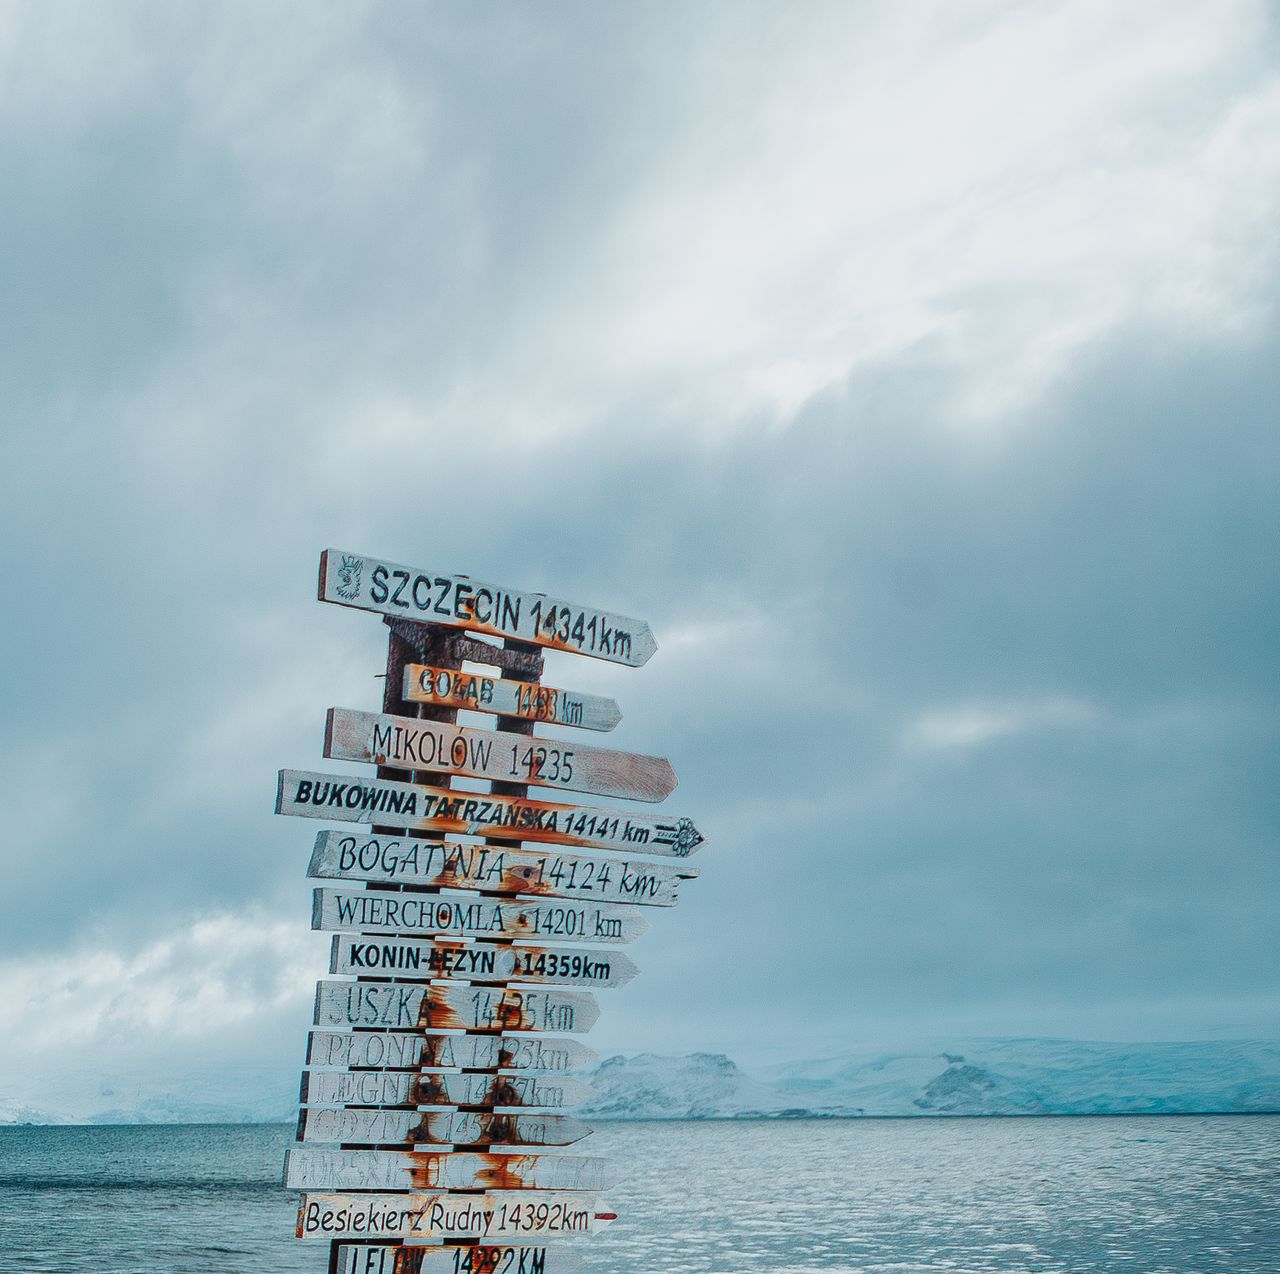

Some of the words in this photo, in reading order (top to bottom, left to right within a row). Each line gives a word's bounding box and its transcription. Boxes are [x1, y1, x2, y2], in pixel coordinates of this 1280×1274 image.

[370, 565, 521, 632] SZCZECIN
[372, 725, 492, 771] MIKOŁÓW
[509, 744, 574, 783] 14235
[294, 780, 417, 815] BUKOWINA
[622, 819, 650, 844] km
[339, 837, 505, 882] BOGATYNIA
[536, 857, 611, 891] 14124
[620, 865, 662, 897] km
[336, 895, 506, 932] WIERCHOMLA
[532, 907, 585, 936] 14201
[595, 911, 622, 937] km
[306, 1202, 423, 1232] Besiekierz
[430, 1203, 492, 1237] Rudny
